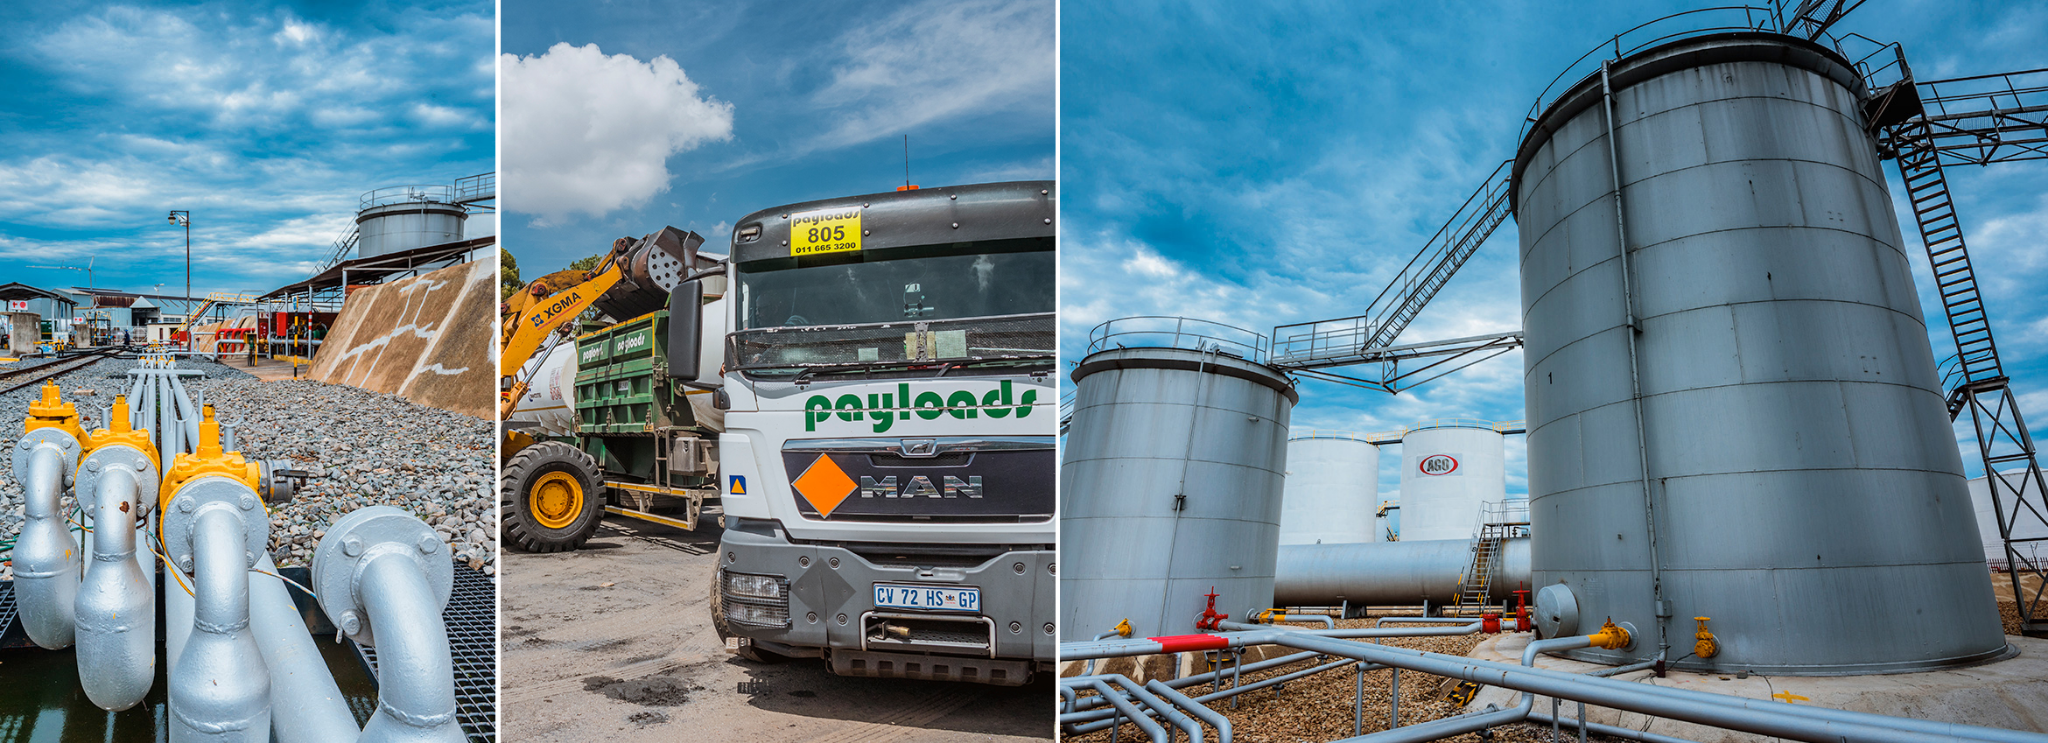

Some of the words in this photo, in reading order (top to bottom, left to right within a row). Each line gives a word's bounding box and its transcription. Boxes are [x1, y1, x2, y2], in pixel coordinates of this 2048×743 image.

[793, 211, 860, 227] payloads
[808, 225, 845, 243] 805
[814, 244, 832, 252] 665
[834, 242, 857, 250] 3200
[543, 292, 582, 319] XGMA
[1548, 371, 1553, 385] 1
[805, 379, 1038, 434] payloads
[1427, 458, 1450, 472] AGO
[860, 475, 984, 499] MAN
[877, 588, 894, 604] CV
[901, 589, 919, 605] 72
[926, 590, 944, 606] HS
[959, 592, 977, 608] GP
